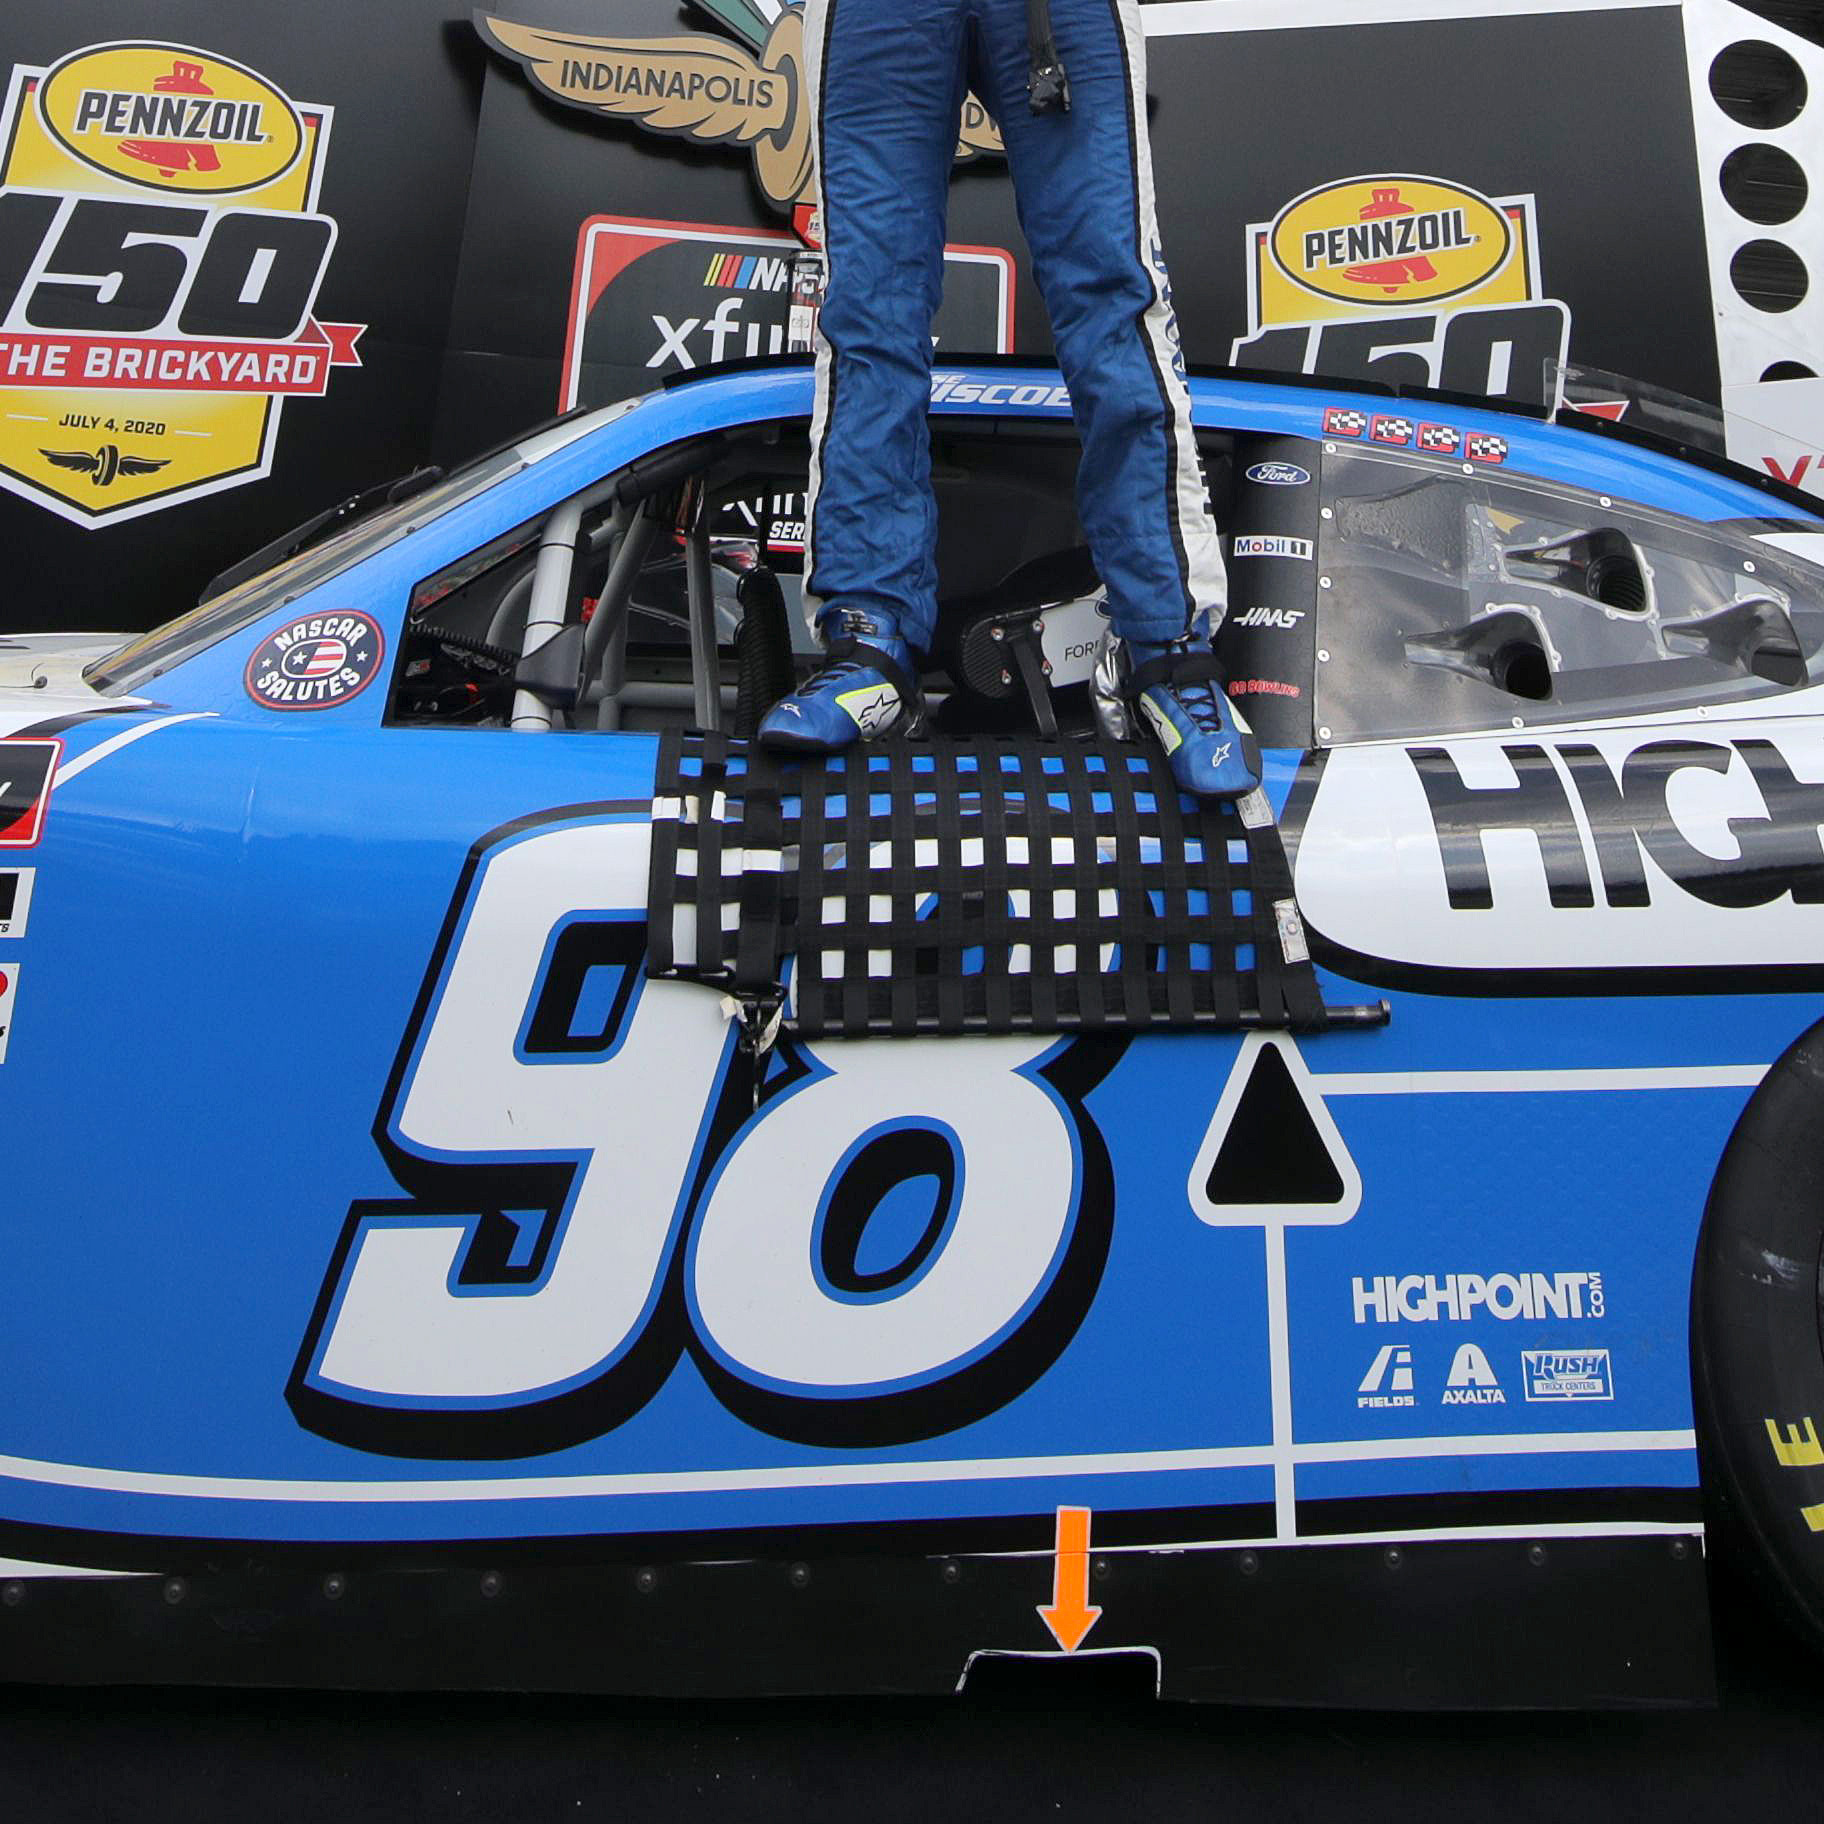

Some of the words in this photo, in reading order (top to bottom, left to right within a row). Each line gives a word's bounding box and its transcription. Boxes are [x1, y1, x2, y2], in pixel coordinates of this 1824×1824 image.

[559, 58, 773, 110] INDIANAPOLIS
[75, 87, 268, 145] PENNZOIL
[1304, 211, 1474, 269] PENNZOIL
[82, 347, 320, 386] BRICKYARD
[931, 383, 1072, 406] ISCOE
[58, 414, 97, 431] JULY
[102, 416, 119, 433] 4,
[124, 419, 166, 435] 2020
[1257, 463, 1297, 481] Ford
[1236, 539, 1286, 553] Mobil
[274, 617, 367, 651] NASCAR
[257, 668, 361, 701] SALUTES
[319, 816, 1086, 1402] 98
[1358, 1395, 1414, 1408] FIELDS
[1441, 1389, 1506, 1404] AXALTA
